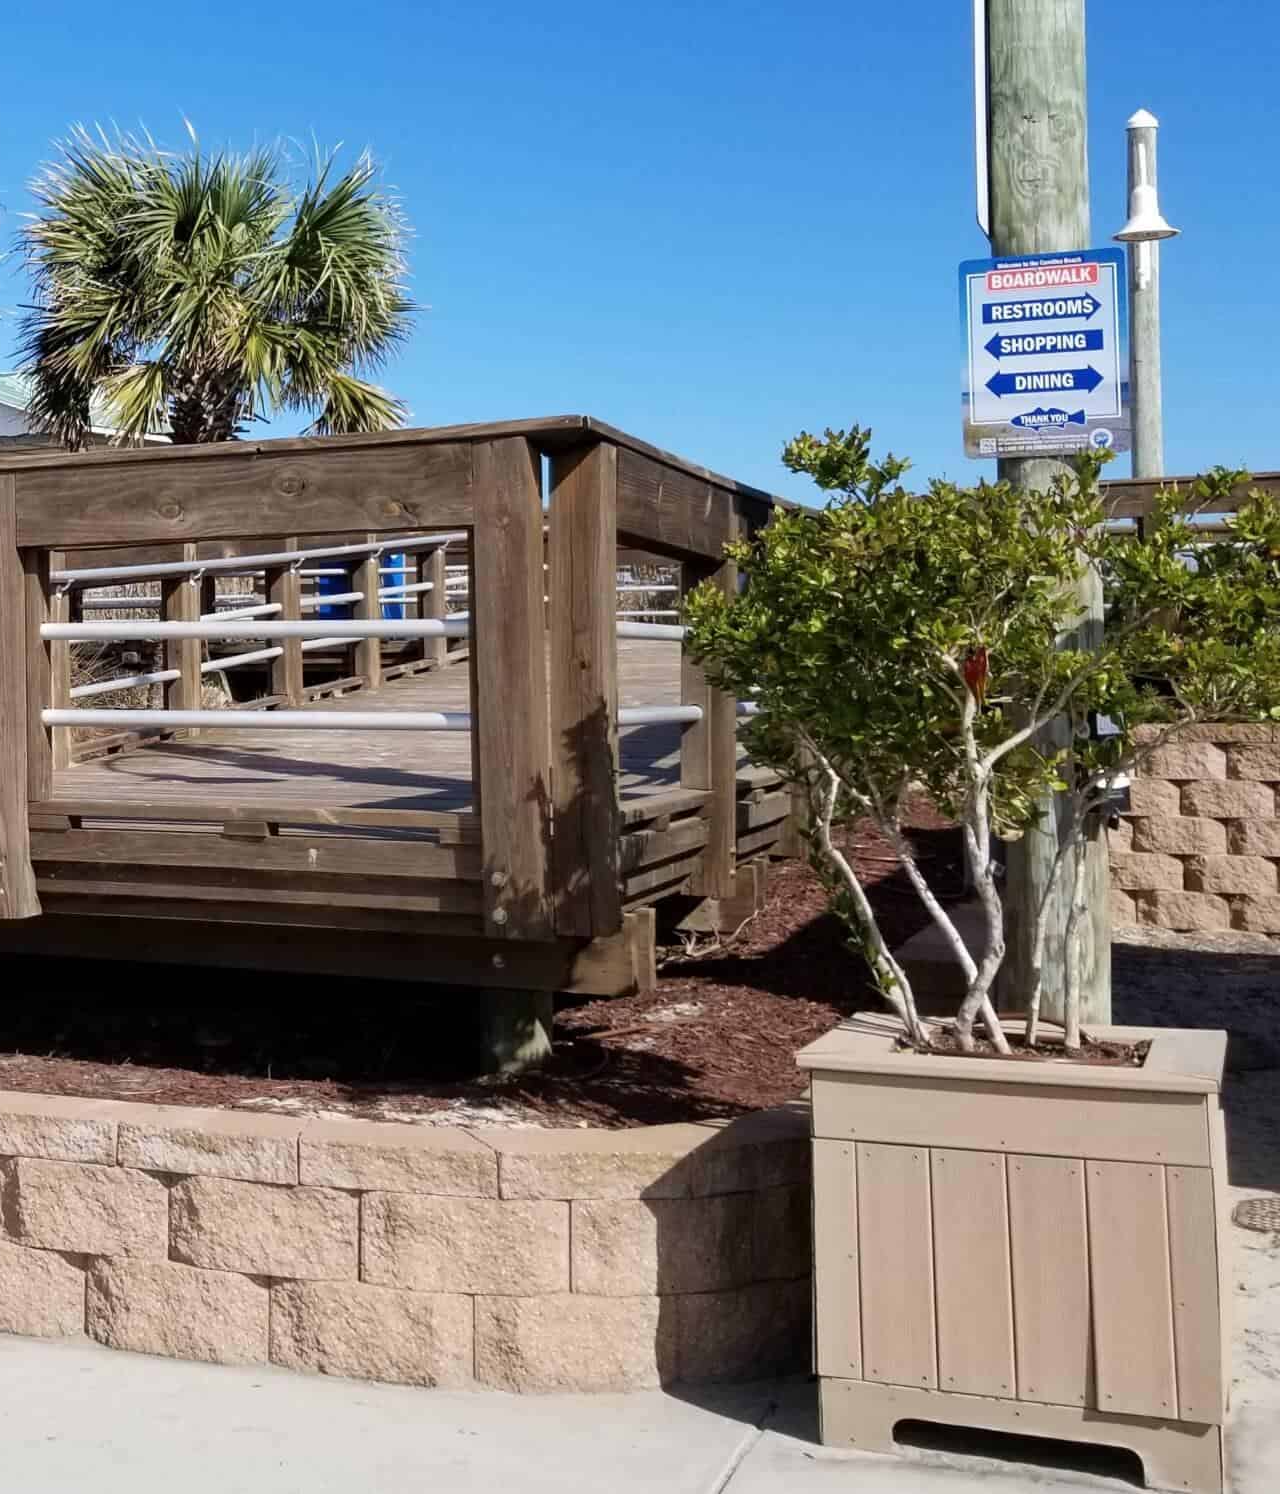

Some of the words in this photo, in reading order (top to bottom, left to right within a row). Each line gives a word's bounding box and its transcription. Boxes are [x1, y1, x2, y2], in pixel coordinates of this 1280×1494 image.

[991, 268, 1091, 289] BOARDWALK
[991, 299, 1094, 321] RESTROOMS
[1000, 334, 1087, 354] SHOPPING
[1015, 374, 1075, 391] DINING
[1021, 414, 1050, 426] THANK
[1050, 413, 1069, 424] YOU
